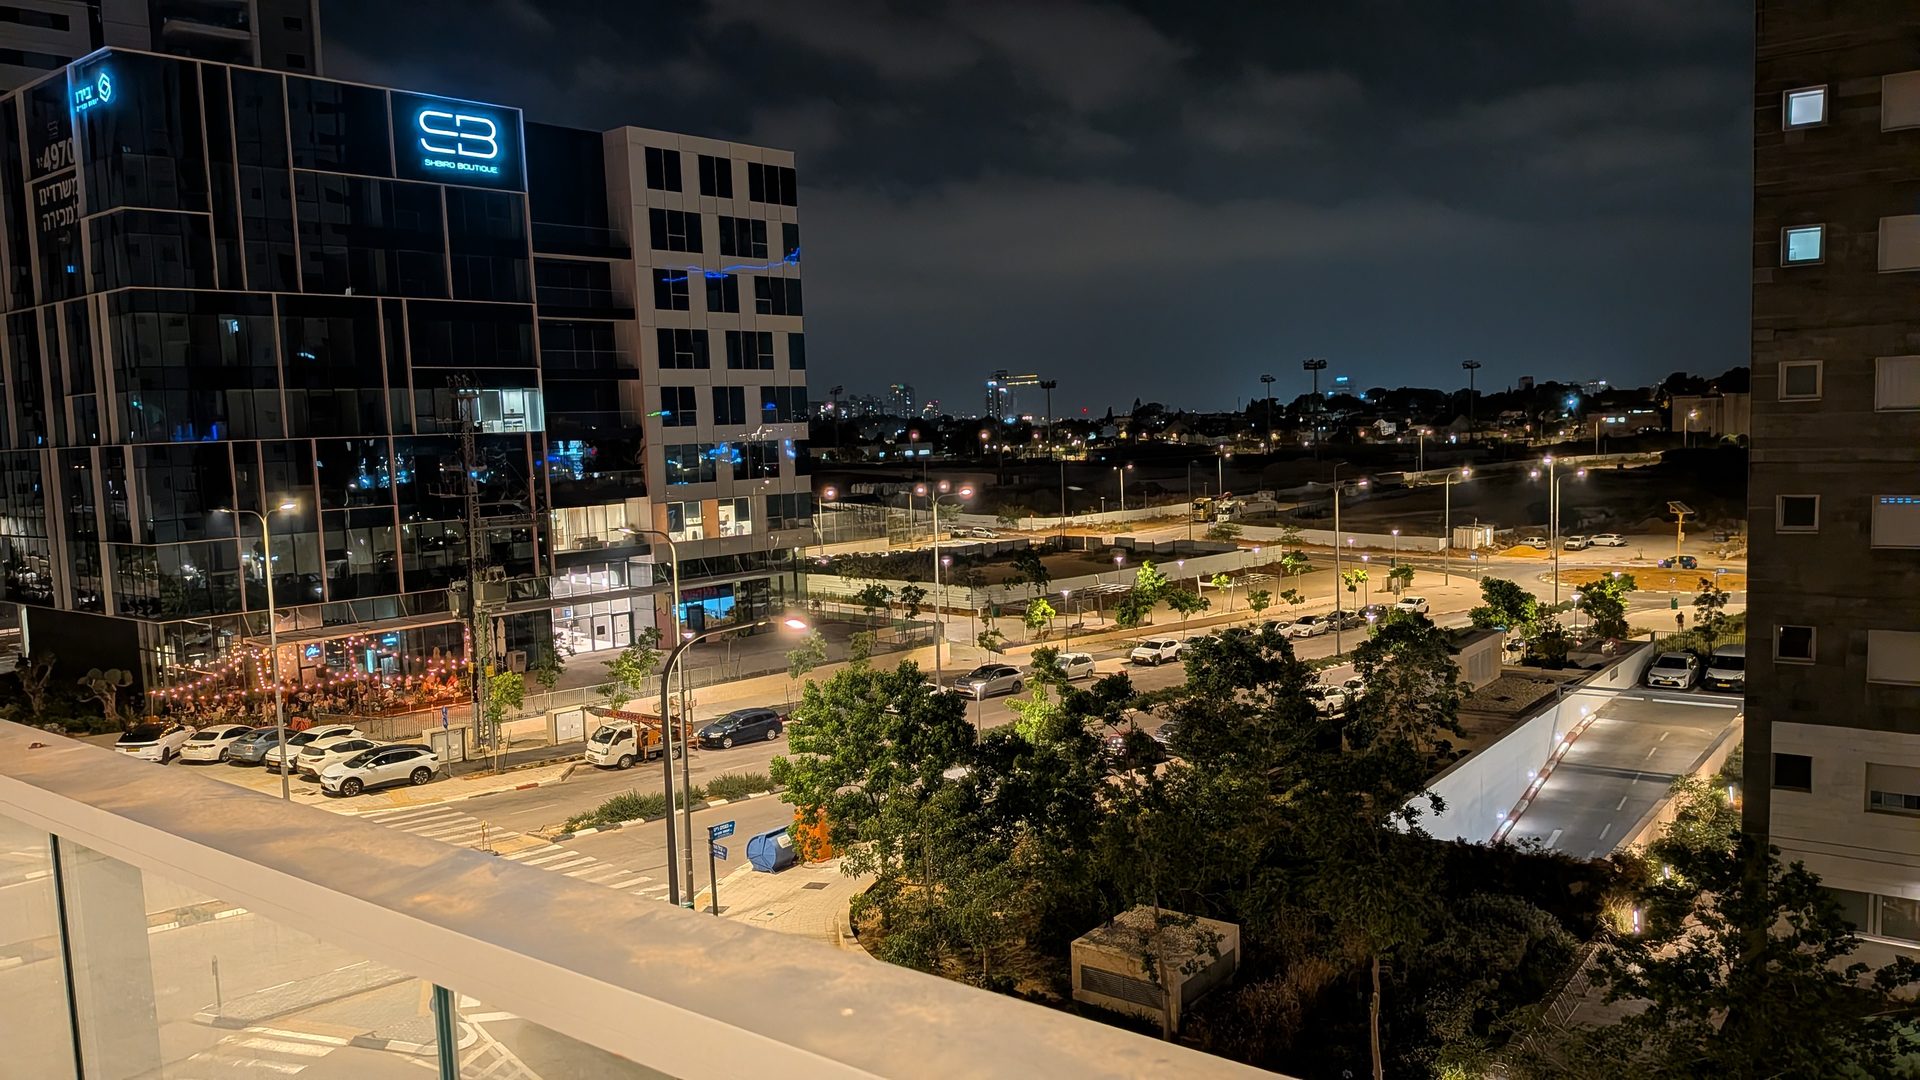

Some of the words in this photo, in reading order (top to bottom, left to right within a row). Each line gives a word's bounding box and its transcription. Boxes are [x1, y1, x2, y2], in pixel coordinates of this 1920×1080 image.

[419, 110, 498, 159] SB
[424, 158, 456, 169] SHBIRO
[457, 162, 498, 174] BOUTIQUE
